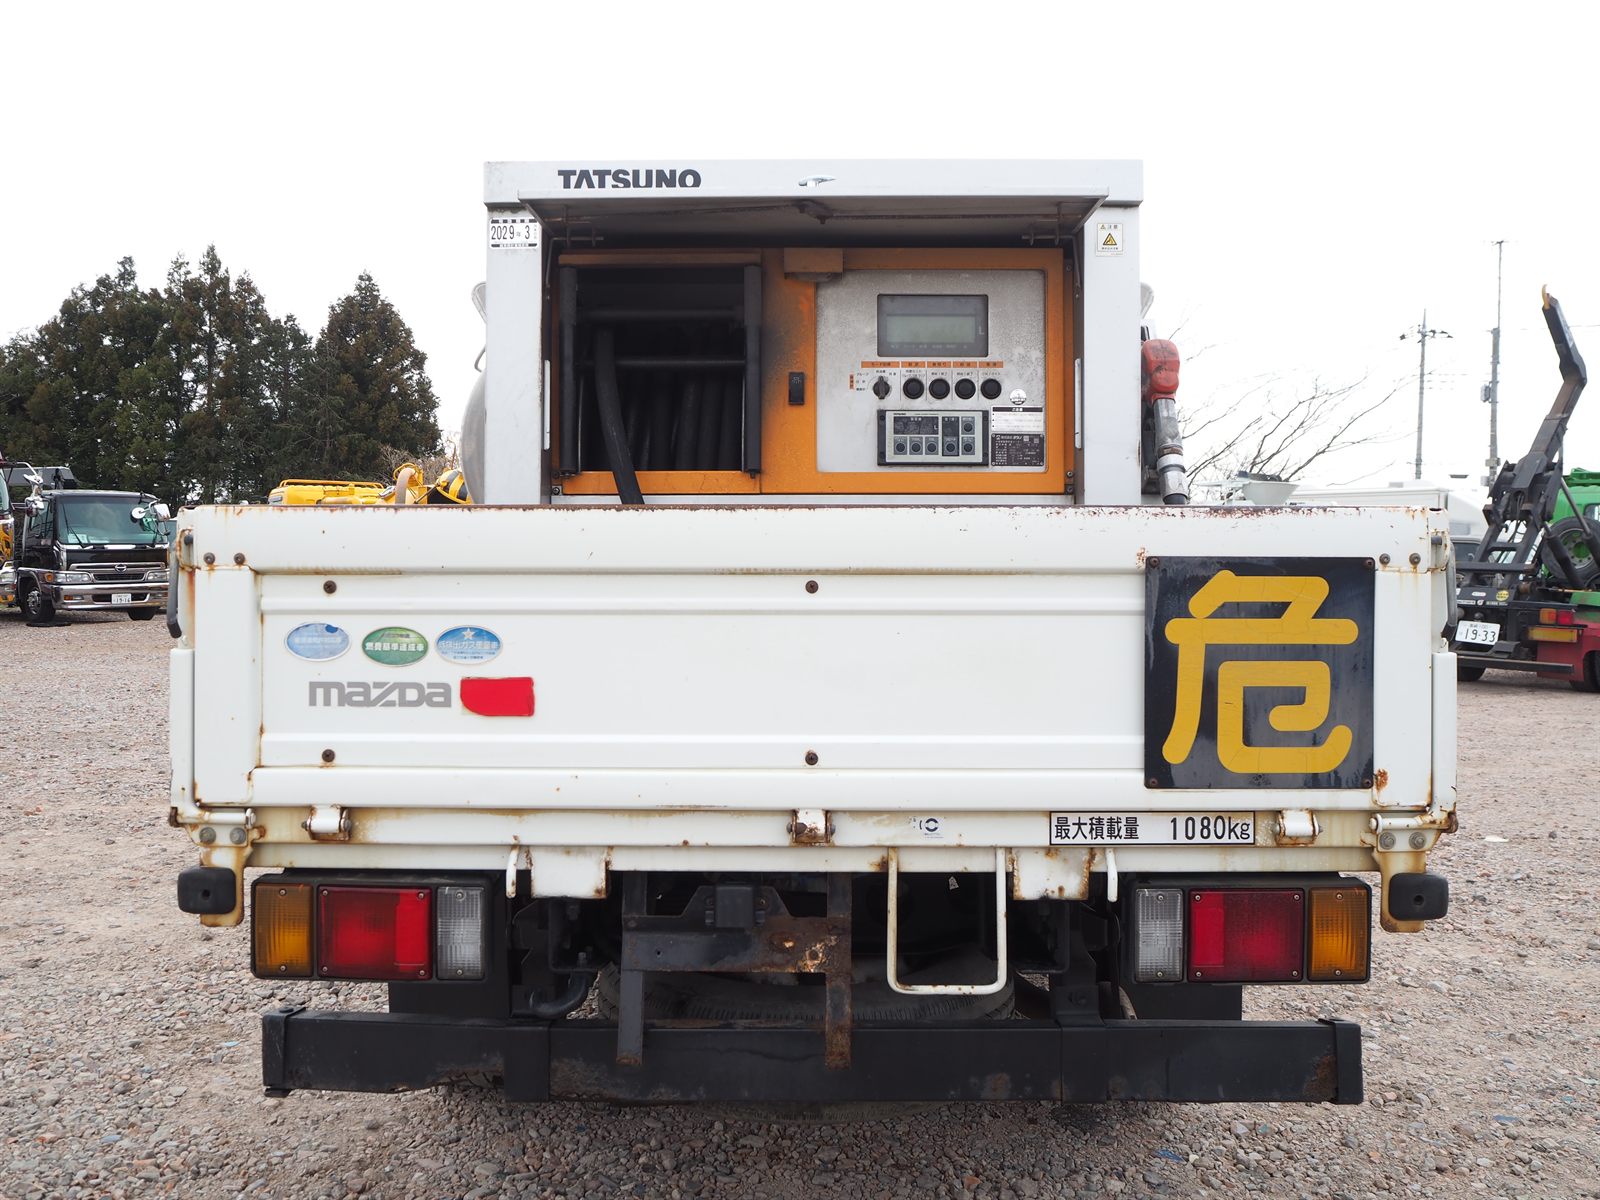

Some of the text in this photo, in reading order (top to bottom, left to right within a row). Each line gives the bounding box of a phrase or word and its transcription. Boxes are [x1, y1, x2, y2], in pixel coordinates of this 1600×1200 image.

[557, 168, 702, 189] TATSUNO
[1161, 569, 1359, 774] 危
[1054, 815, 1251, 842] 最大積載量 1080kg
